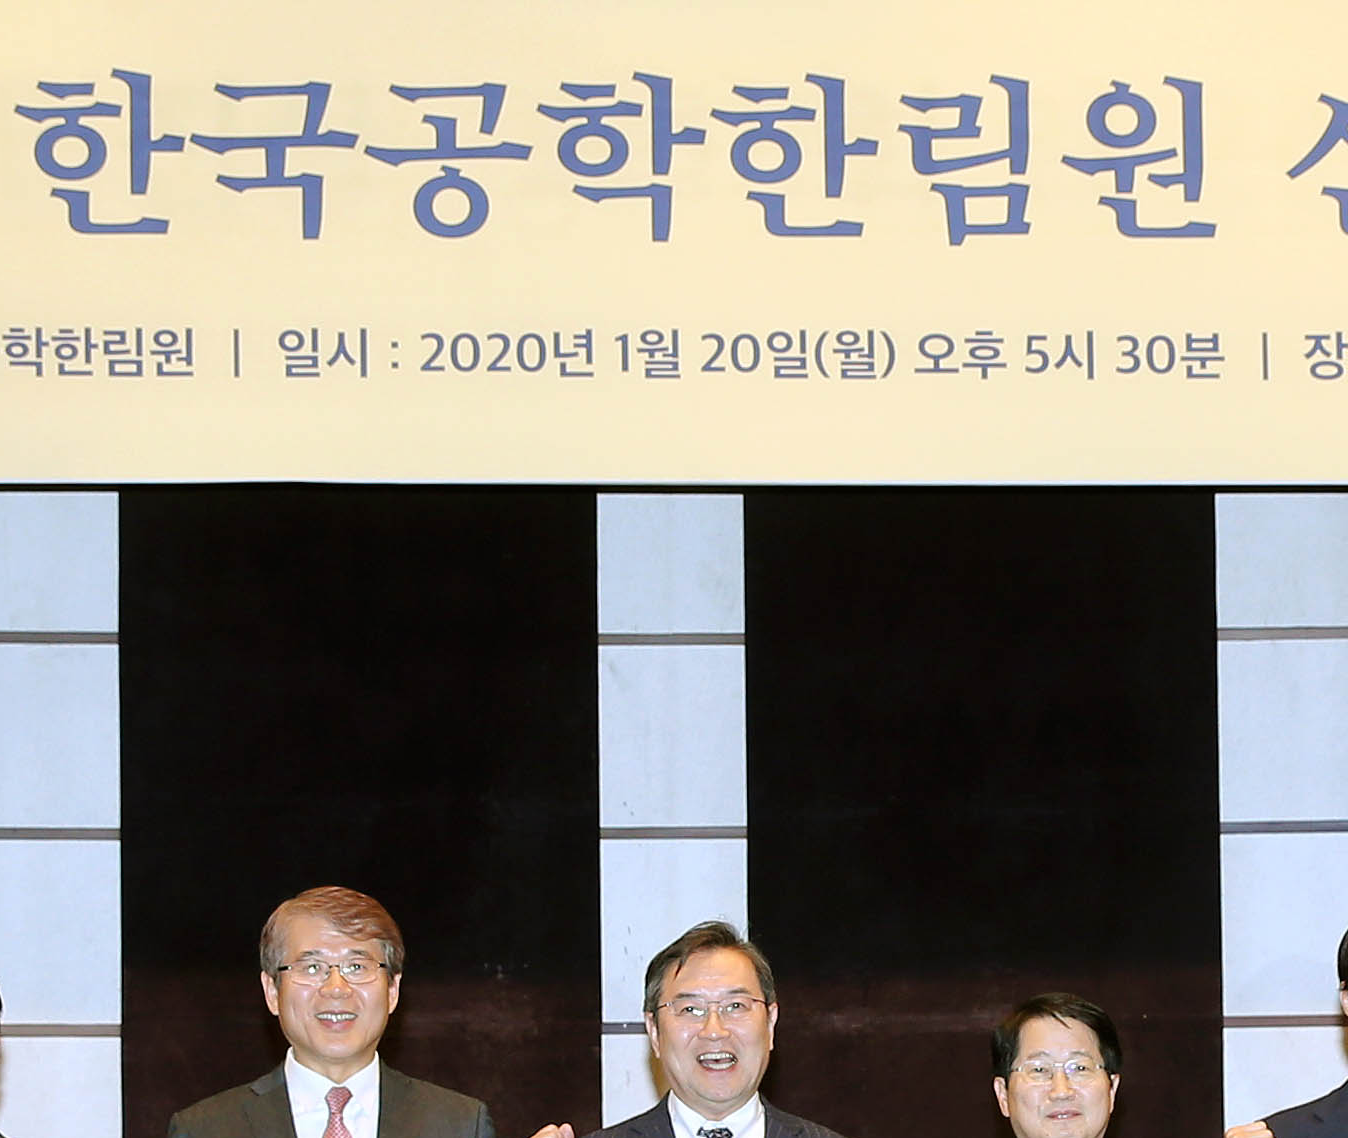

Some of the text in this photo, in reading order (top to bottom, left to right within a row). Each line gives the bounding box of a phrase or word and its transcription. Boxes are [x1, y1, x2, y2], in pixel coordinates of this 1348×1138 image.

[15, 69, 1216, 245] 한국공학한림원
[278, 327, 367, 377] 일시
[420, 329, 594, 378] 2020년
[615, 330, 681, 379] 1월
[701, 329, 895, 379] 20일(월)
[914, 330, 1007, 379] 오후
[1025, 330, 1094, 380] 5시
[1116, 333, 1225, 379] 30분
